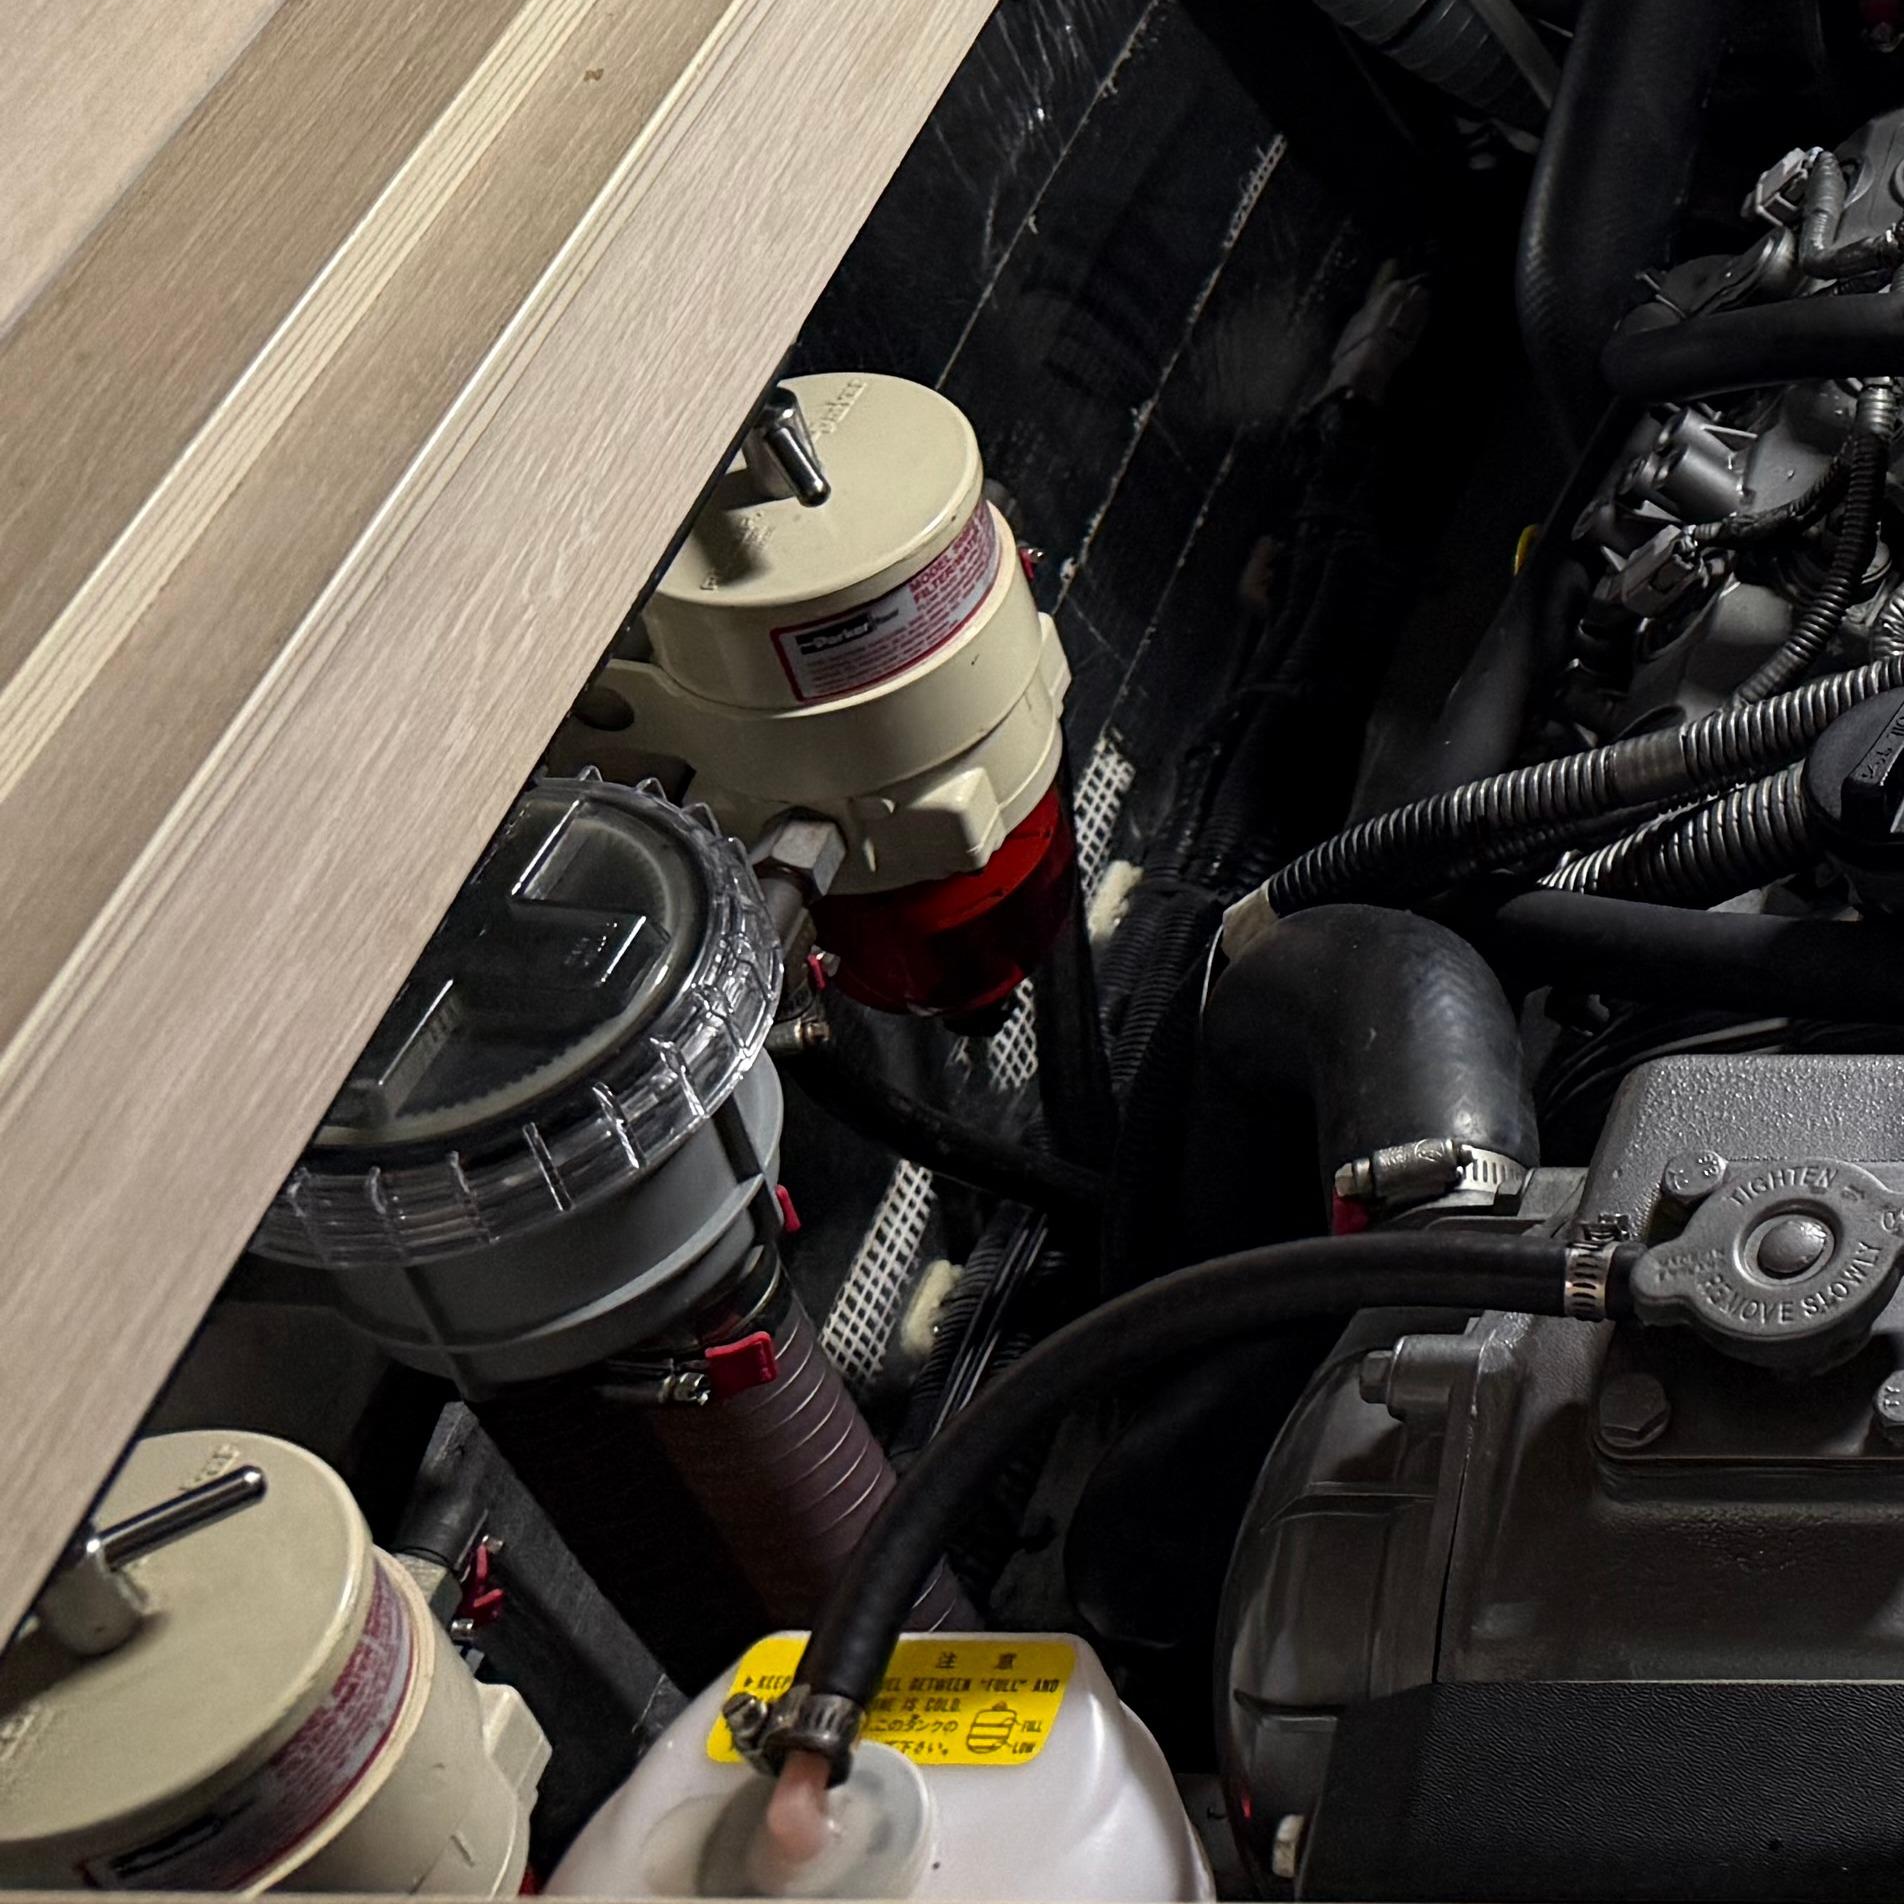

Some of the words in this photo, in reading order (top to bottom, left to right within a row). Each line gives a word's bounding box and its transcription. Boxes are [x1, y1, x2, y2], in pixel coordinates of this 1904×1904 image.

[814, 621, 870, 648] Parker
[1729, 1166, 1840, 1207] TIGHTEN
[1703, 1273, 1795, 1325] REMOVE
[1802, 1241, 1884, 1319] SLOWLY
[909, 1677, 970, 1691] BETWEEN
[1032, 1679, 1060, 1692] AND
